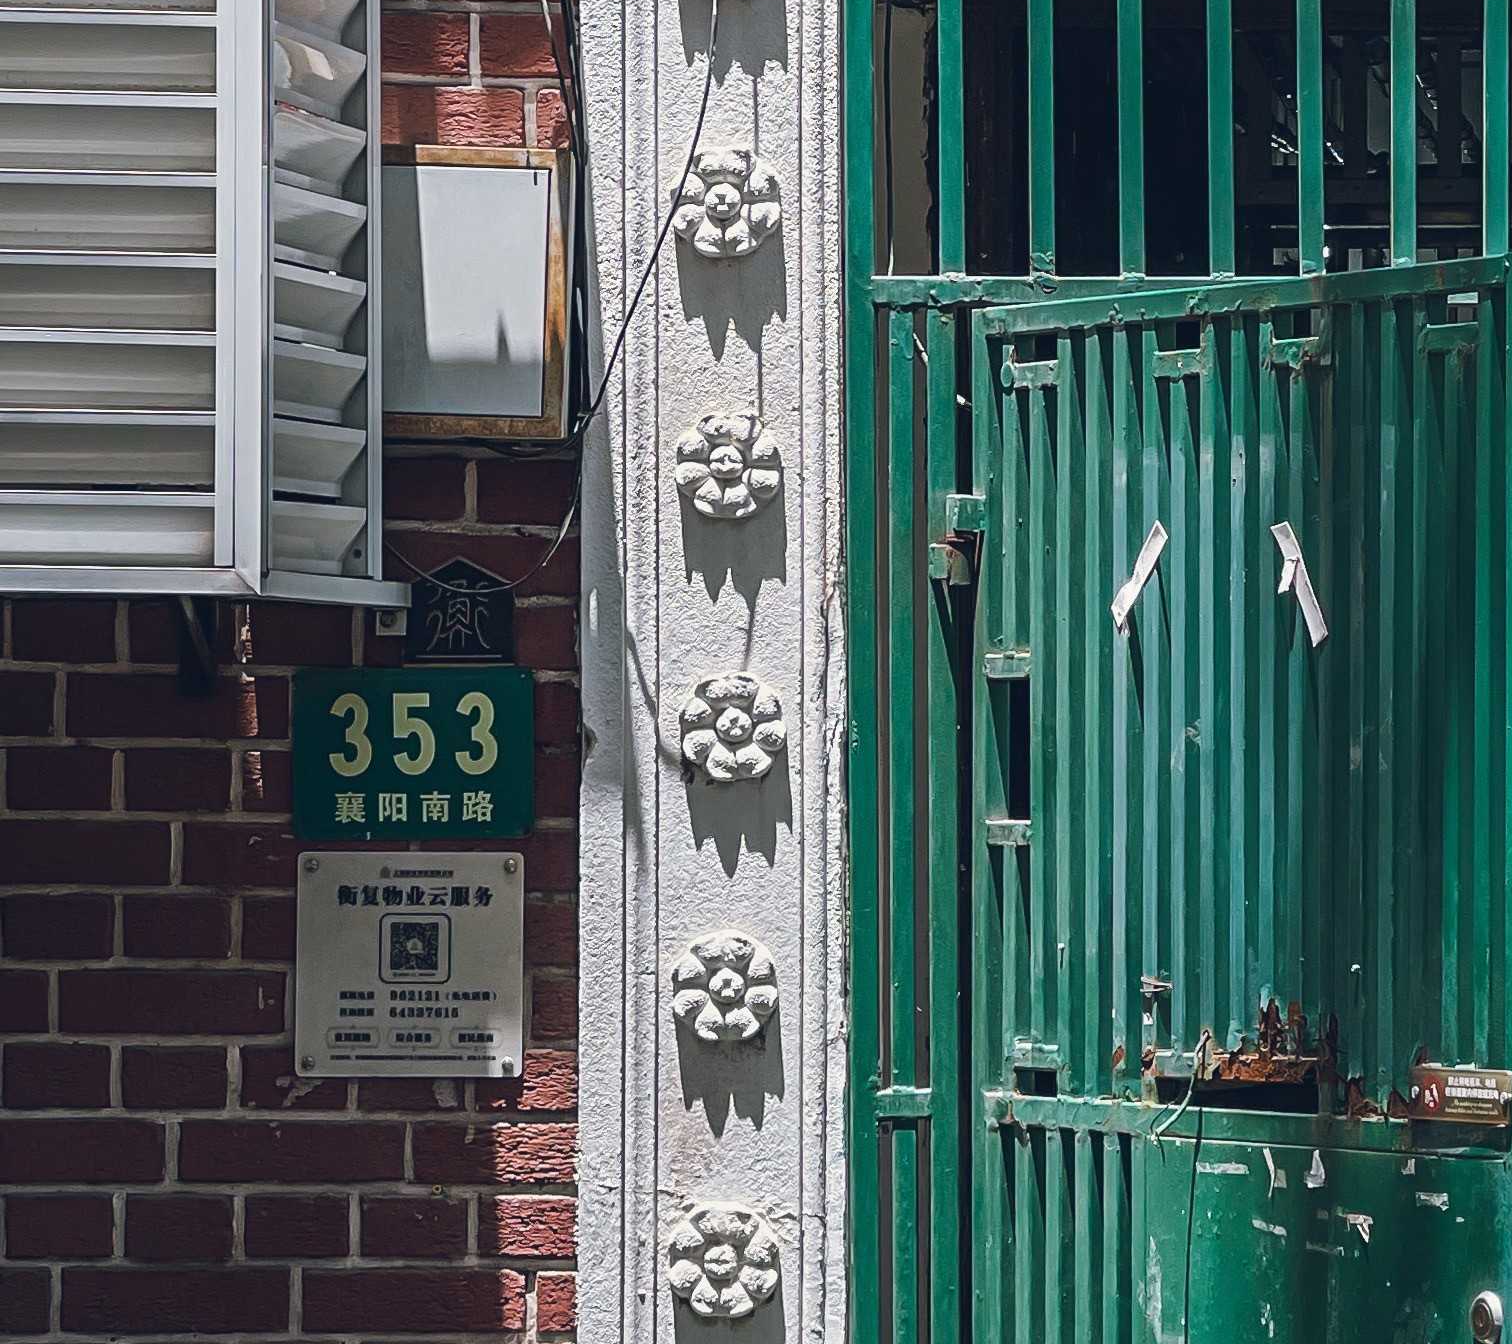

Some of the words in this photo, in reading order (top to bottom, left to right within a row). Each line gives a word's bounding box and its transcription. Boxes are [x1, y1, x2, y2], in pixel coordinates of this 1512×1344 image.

[328, 691, 498, 777] 353
[334, 790, 494, 824] 襄阳南路
